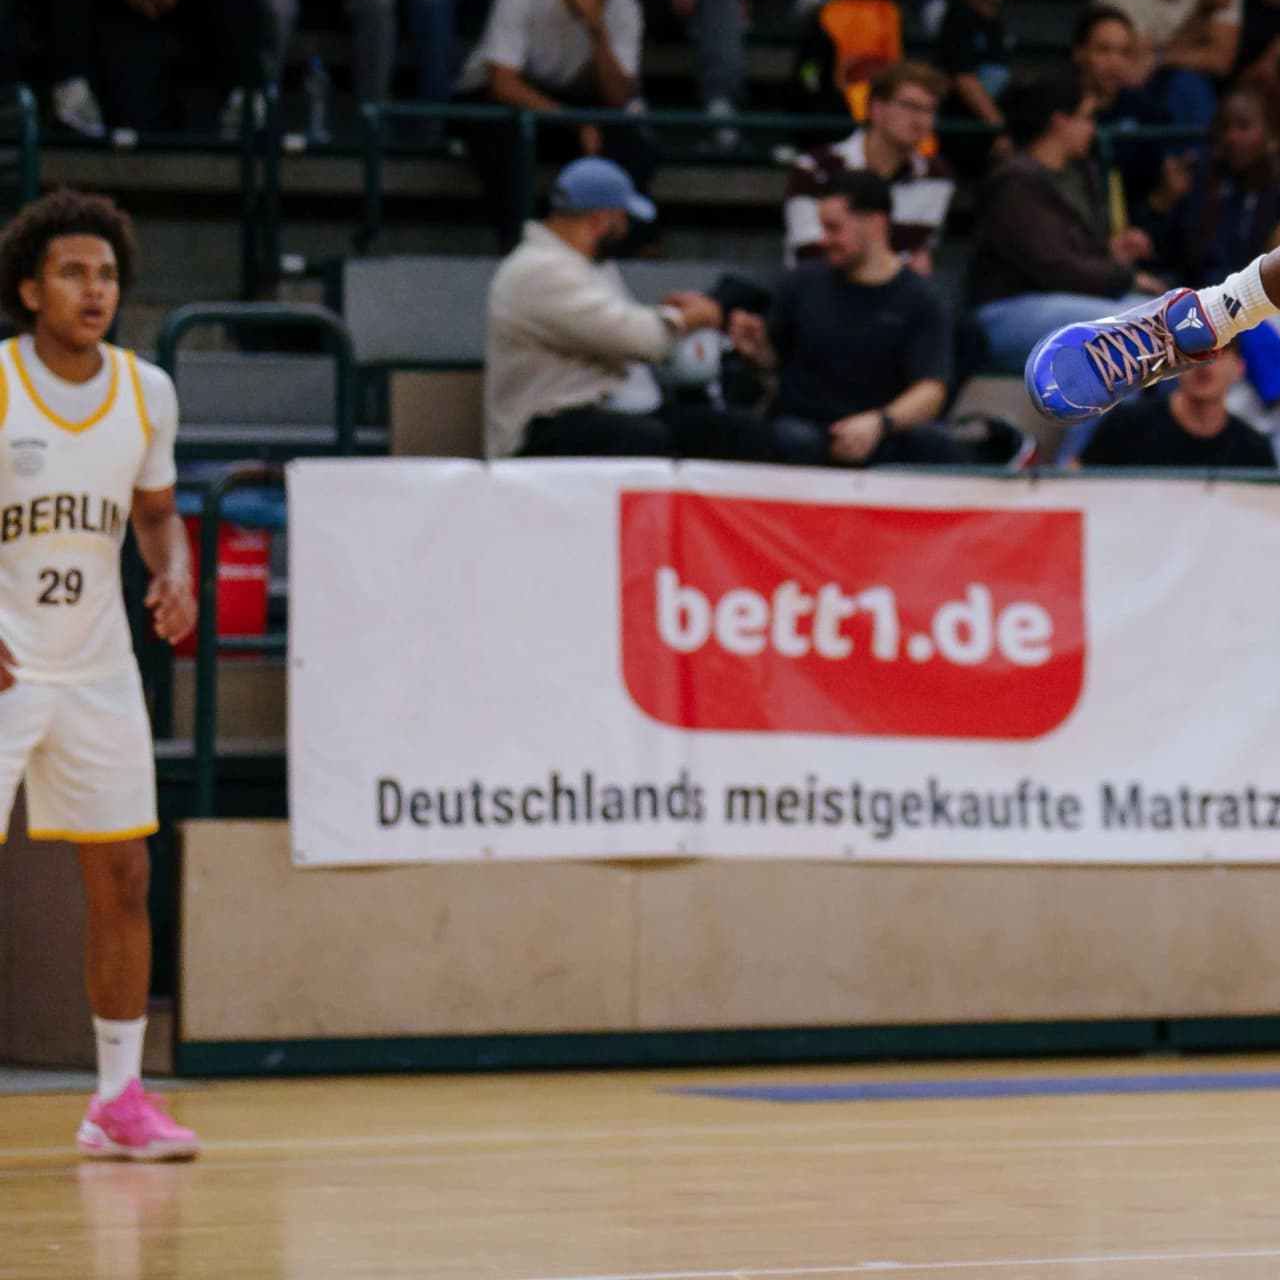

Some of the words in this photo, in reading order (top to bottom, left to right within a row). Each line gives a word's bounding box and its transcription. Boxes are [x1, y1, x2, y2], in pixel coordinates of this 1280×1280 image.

[38, 567, 83, 605] 29
[655, 565, 1054, 667] bett1.de
[376, 769, 706, 827] Deutschlands
[725, 774, 1082, 840] meistgekaufte
